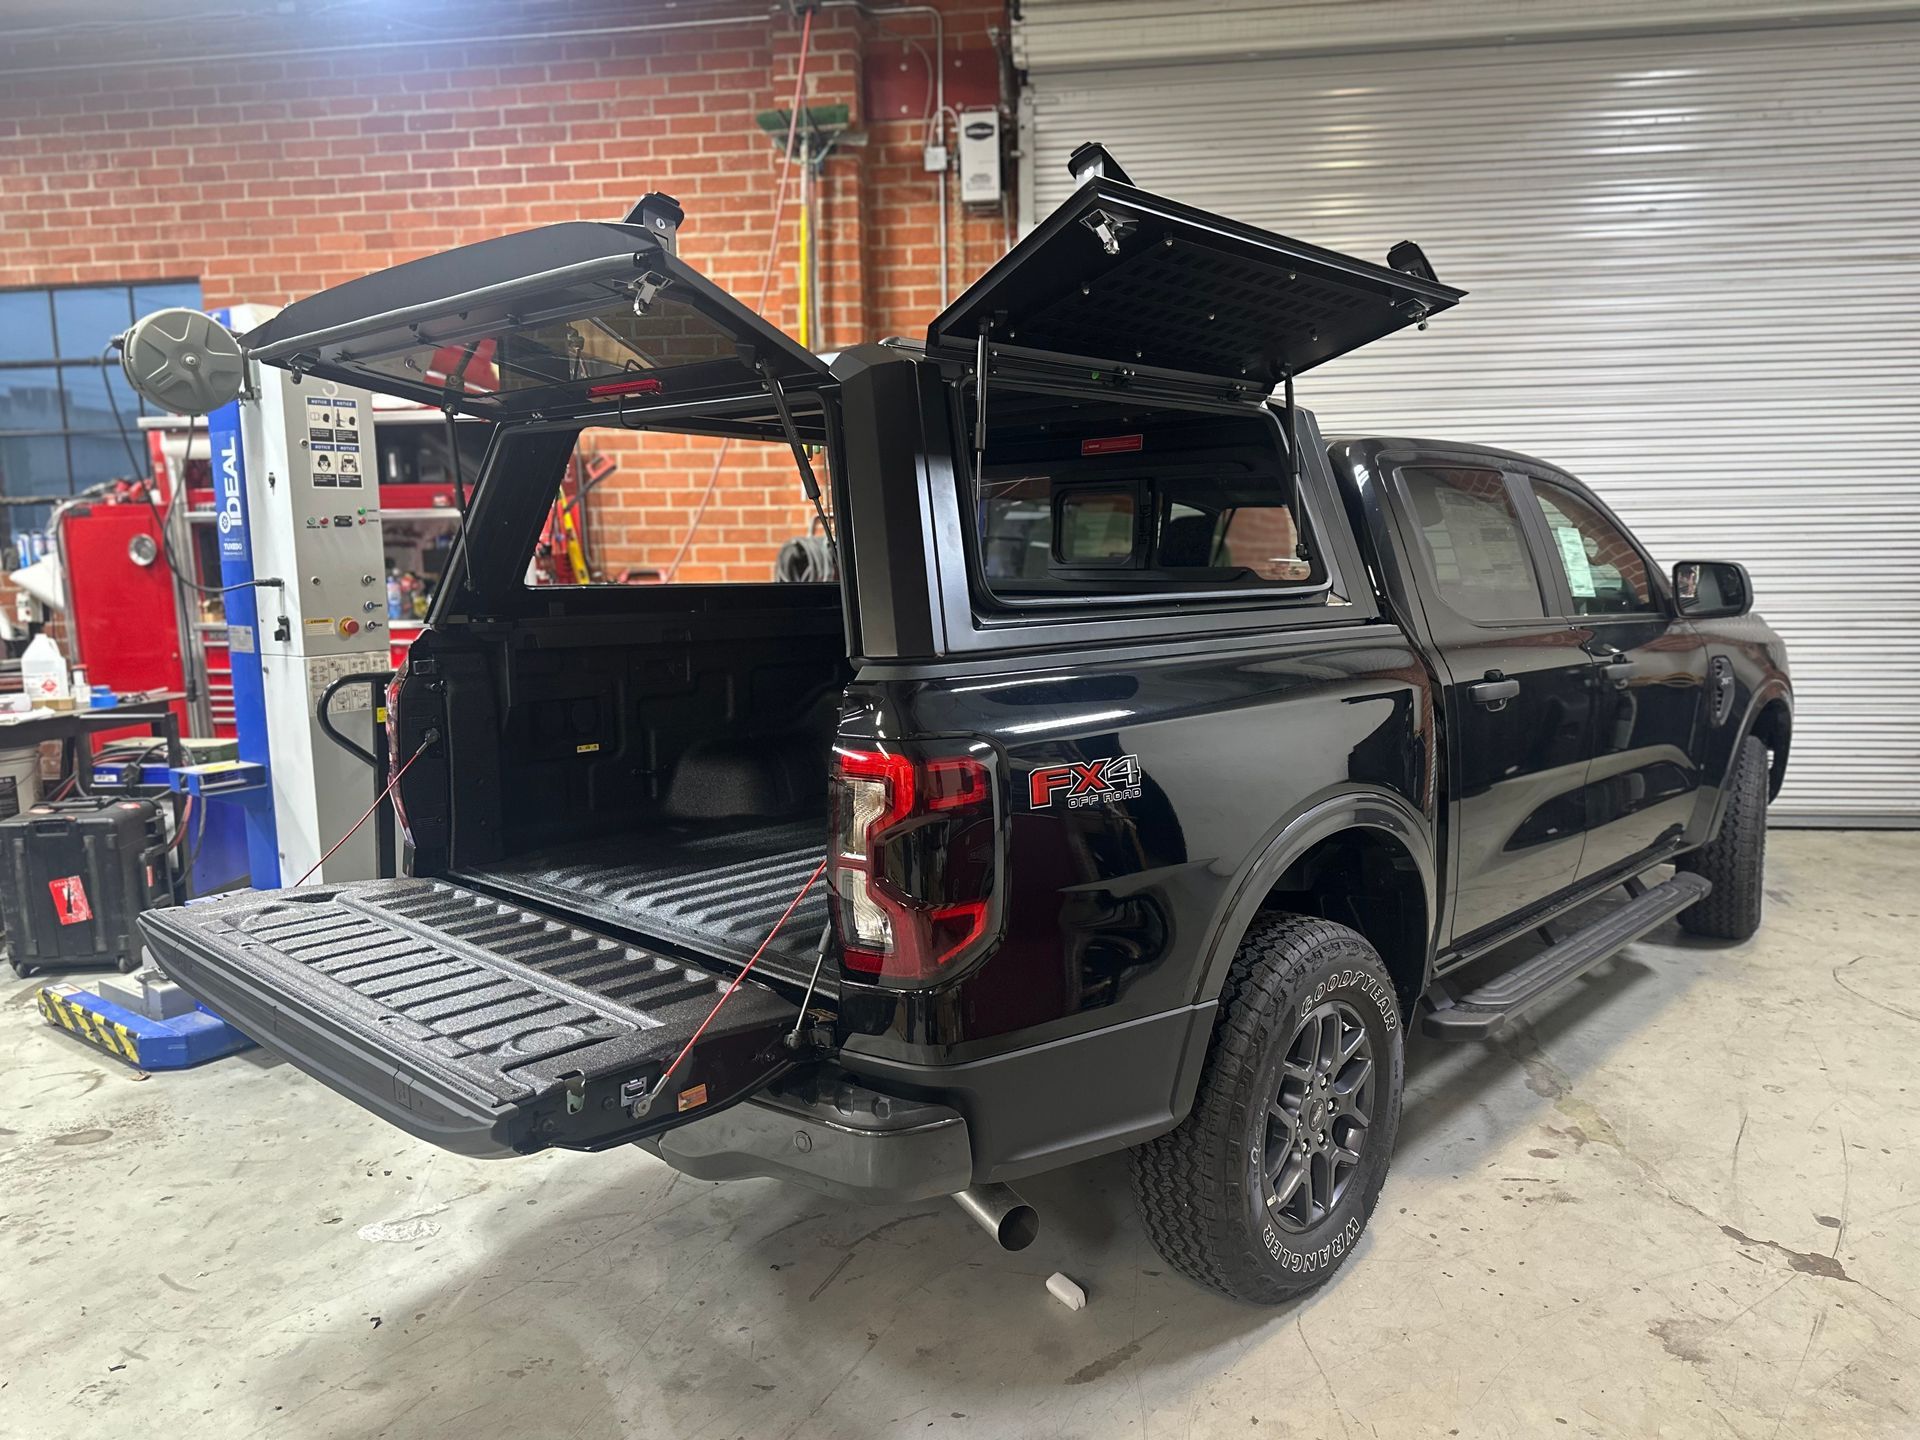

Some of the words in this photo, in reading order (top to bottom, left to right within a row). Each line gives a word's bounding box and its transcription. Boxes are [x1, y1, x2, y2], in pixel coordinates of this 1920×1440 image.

[1029, 754, 1141, 809] FX4
[1067, 796, 1099, 809] OFF
[1103, 787, 1142, 803] ROAD
[1301, 970, 1397, 1031] GOODYEAR
[1263, 1217, 1360, 1272] WRANGLER
